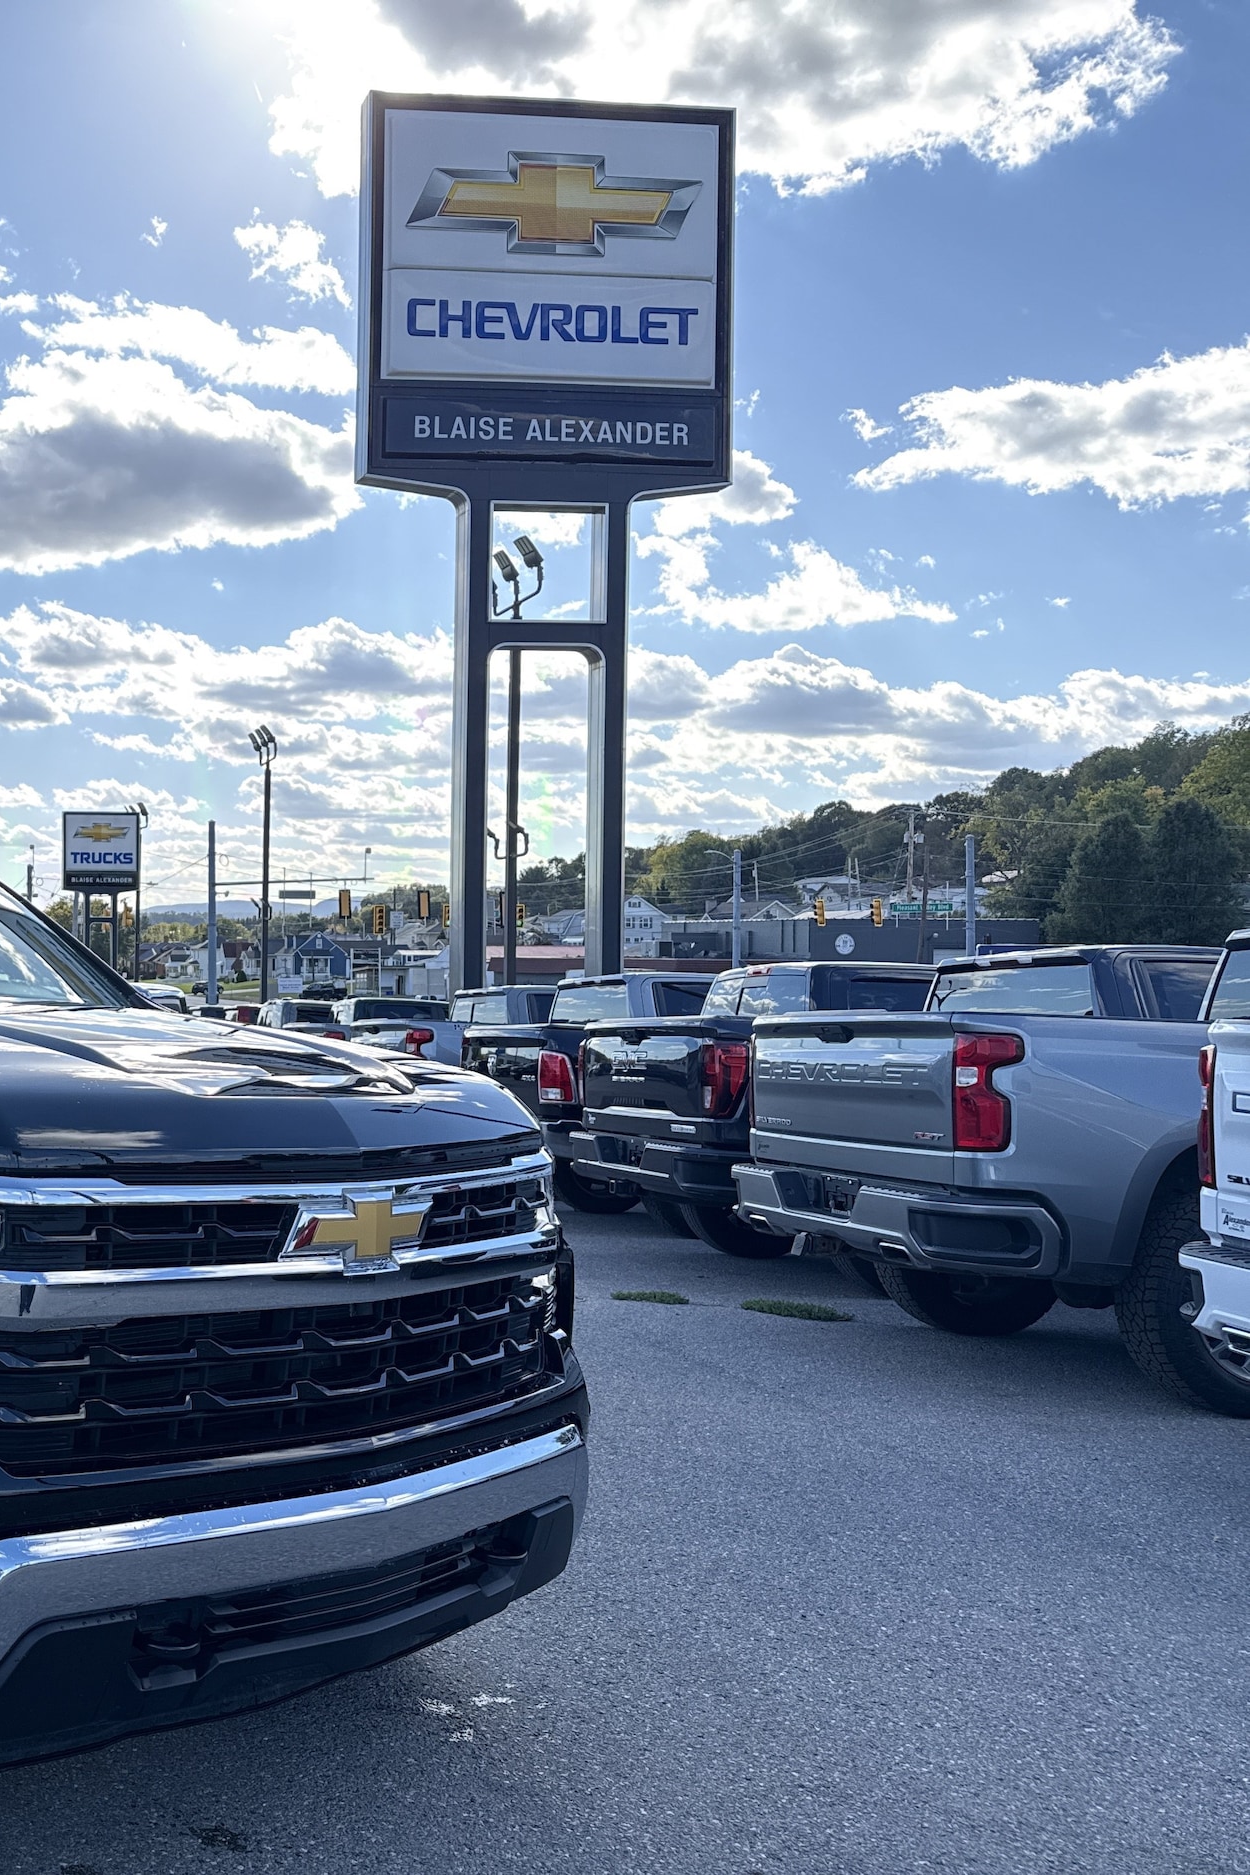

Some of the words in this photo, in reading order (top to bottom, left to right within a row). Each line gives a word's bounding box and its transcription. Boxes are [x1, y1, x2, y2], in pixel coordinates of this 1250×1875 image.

[407, 297, 699, 346] CHEVROLET
[413, 415, 514, 441] BLAISE
[525, 418, 690, 446] ALEXANDER
[70, 852, 133, 864] TRUCKS
[71, 876, 94, 884] BLAISE
[611, 1051, 648, 1070] GMC
[757, 1061, 929, 1086] CHEVROLET
[755, 1115, 793, 1127] SILVERADO
